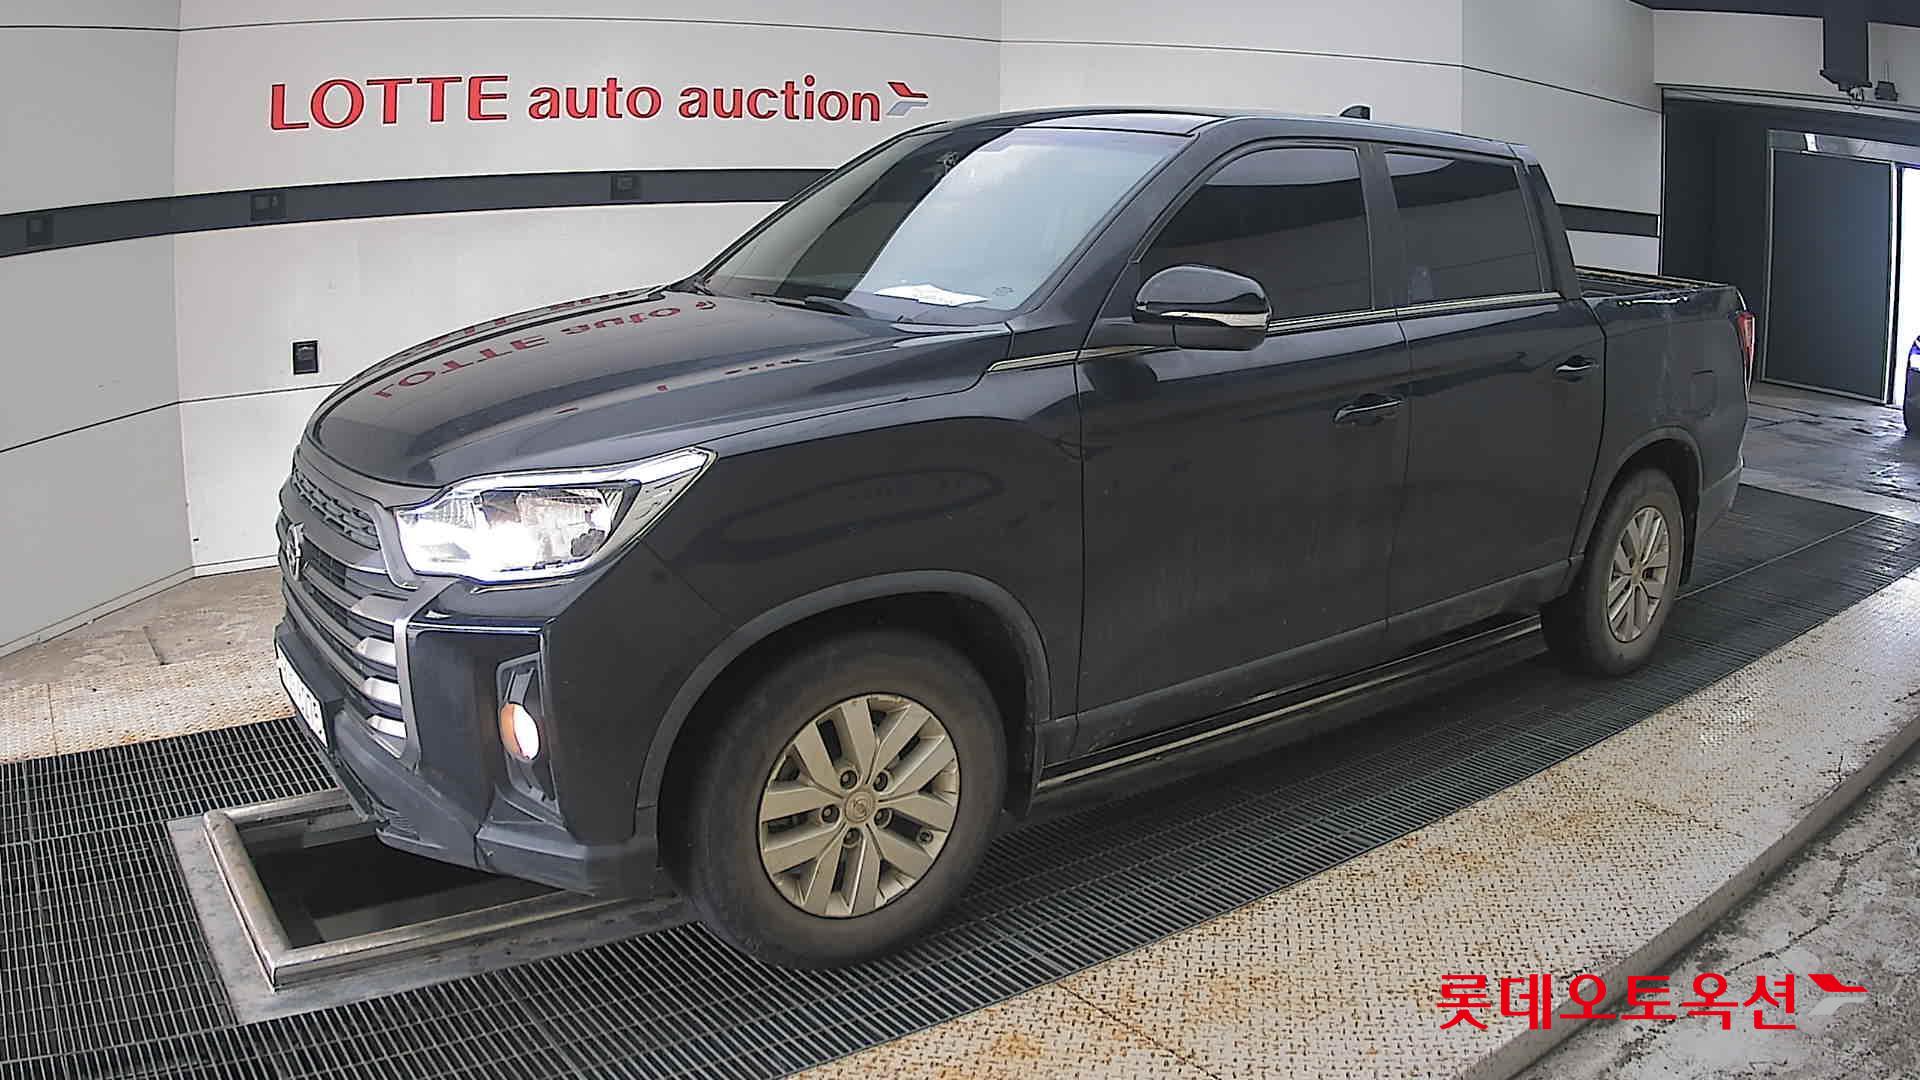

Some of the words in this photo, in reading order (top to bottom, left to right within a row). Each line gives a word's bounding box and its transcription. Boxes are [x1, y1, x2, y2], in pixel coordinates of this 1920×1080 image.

[269, 75, 508, 130] LOTTE
[527, 77, 663, 120] auto
[678, 75, 881, 121] auction
